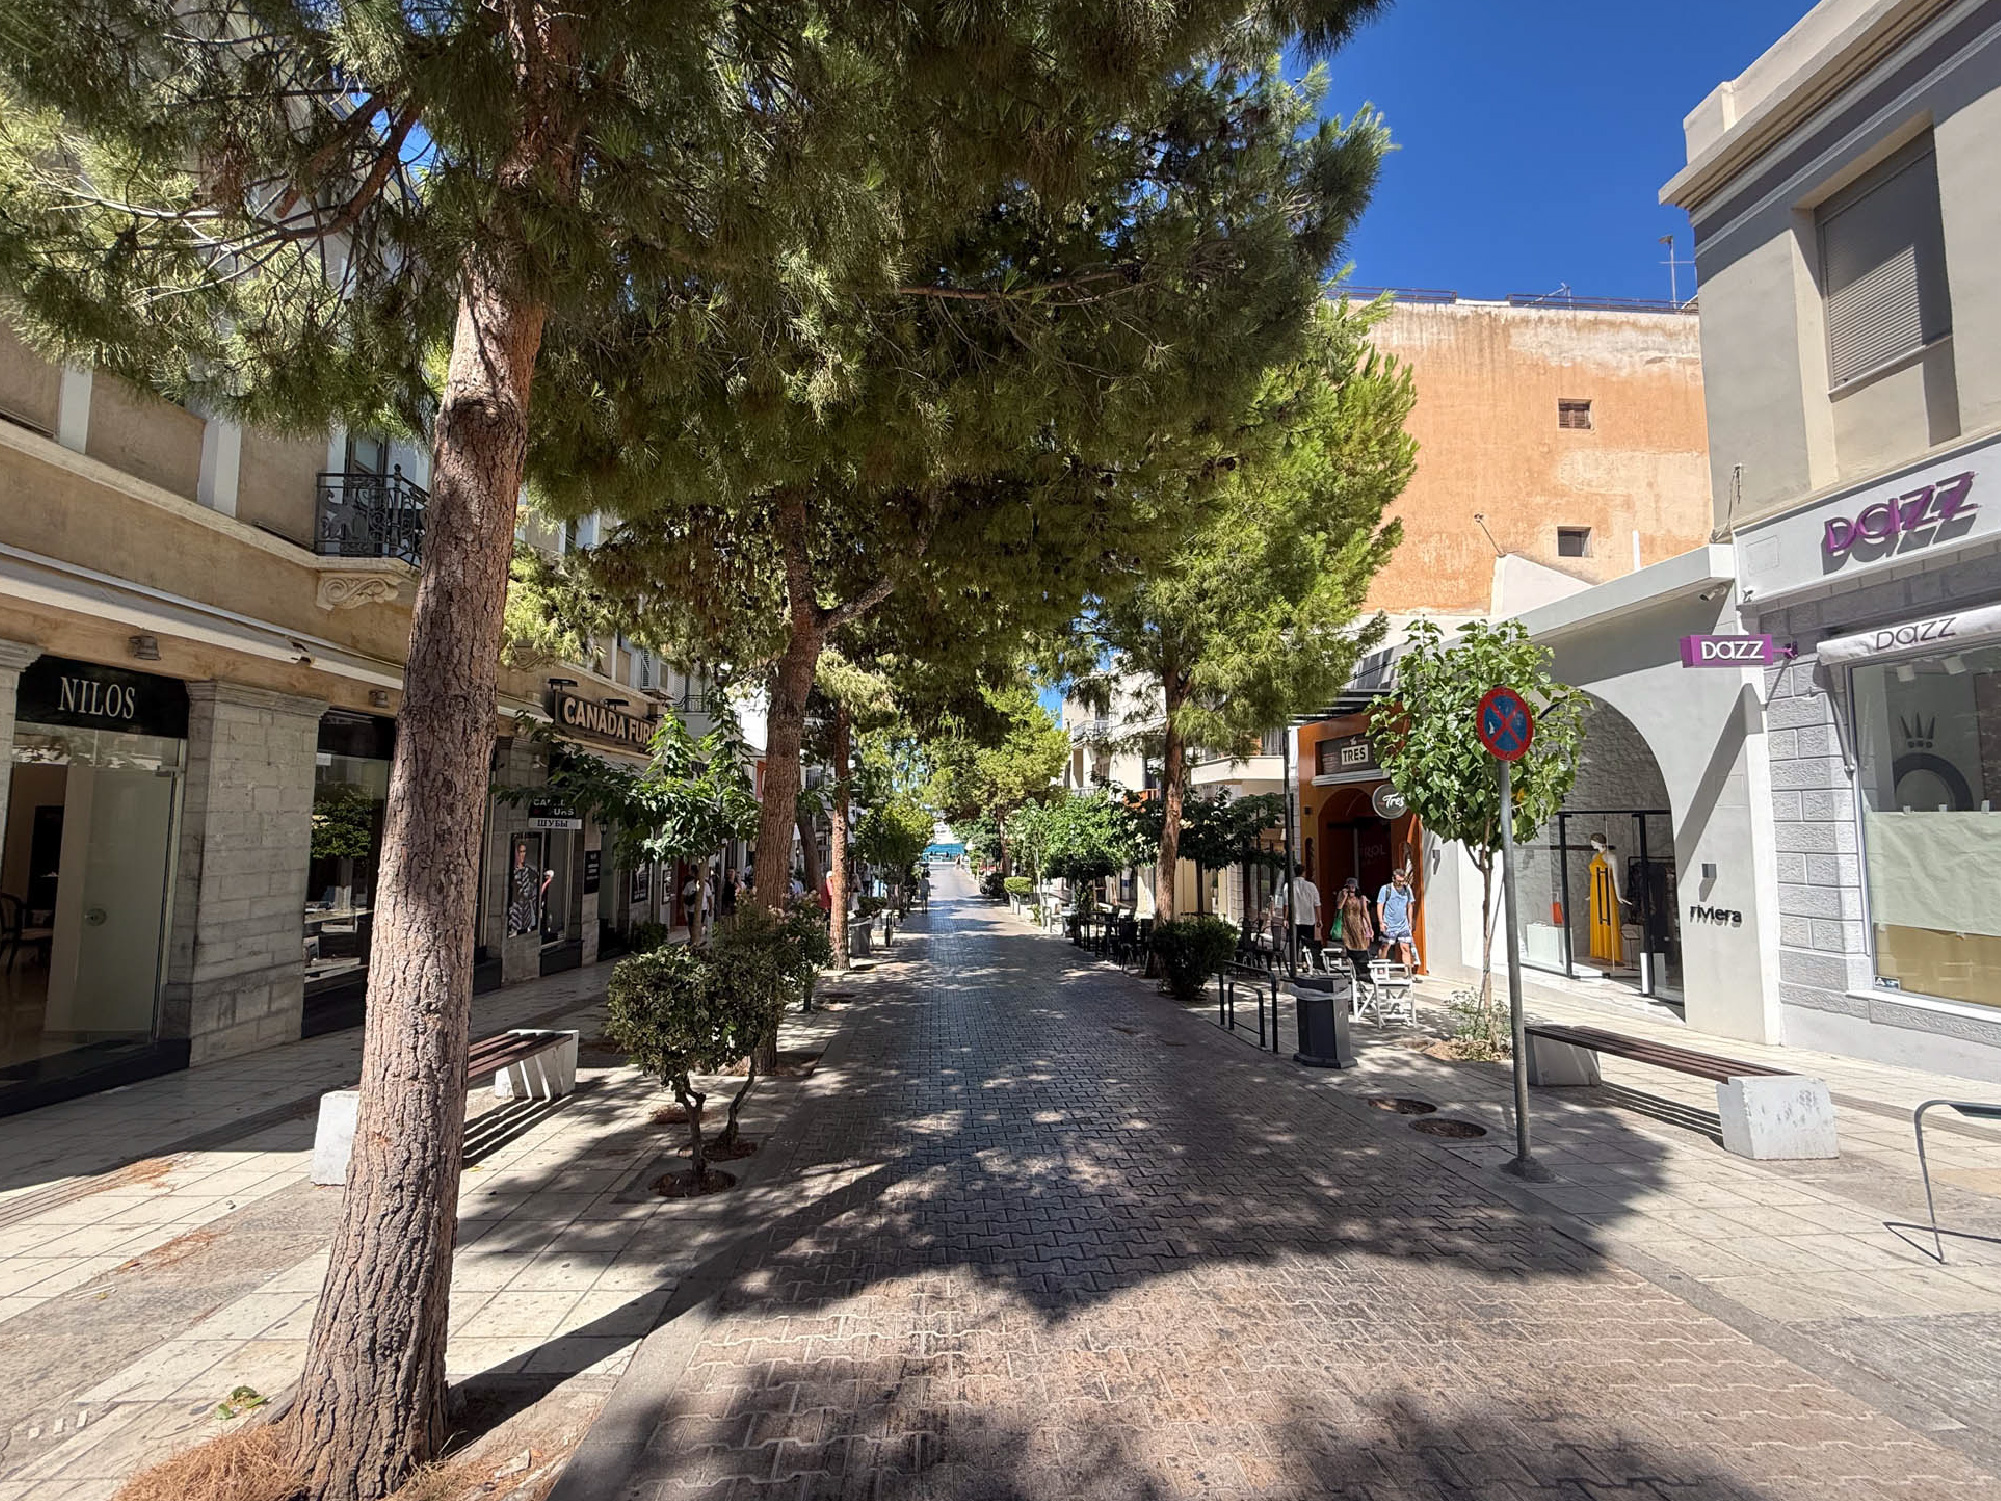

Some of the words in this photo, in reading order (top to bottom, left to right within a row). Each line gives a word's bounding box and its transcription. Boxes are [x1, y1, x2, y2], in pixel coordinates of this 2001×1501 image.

[57, 676, 136, 719] NILOS
[564, 697, 626, 739] CANADA
[1343, 747, 1366, 762] TRES
[1382, 792, 1404, 808] Tres
[537, 819, 568, 828] ШУБЫ
[1689, 904, 1743, 923] riviera
